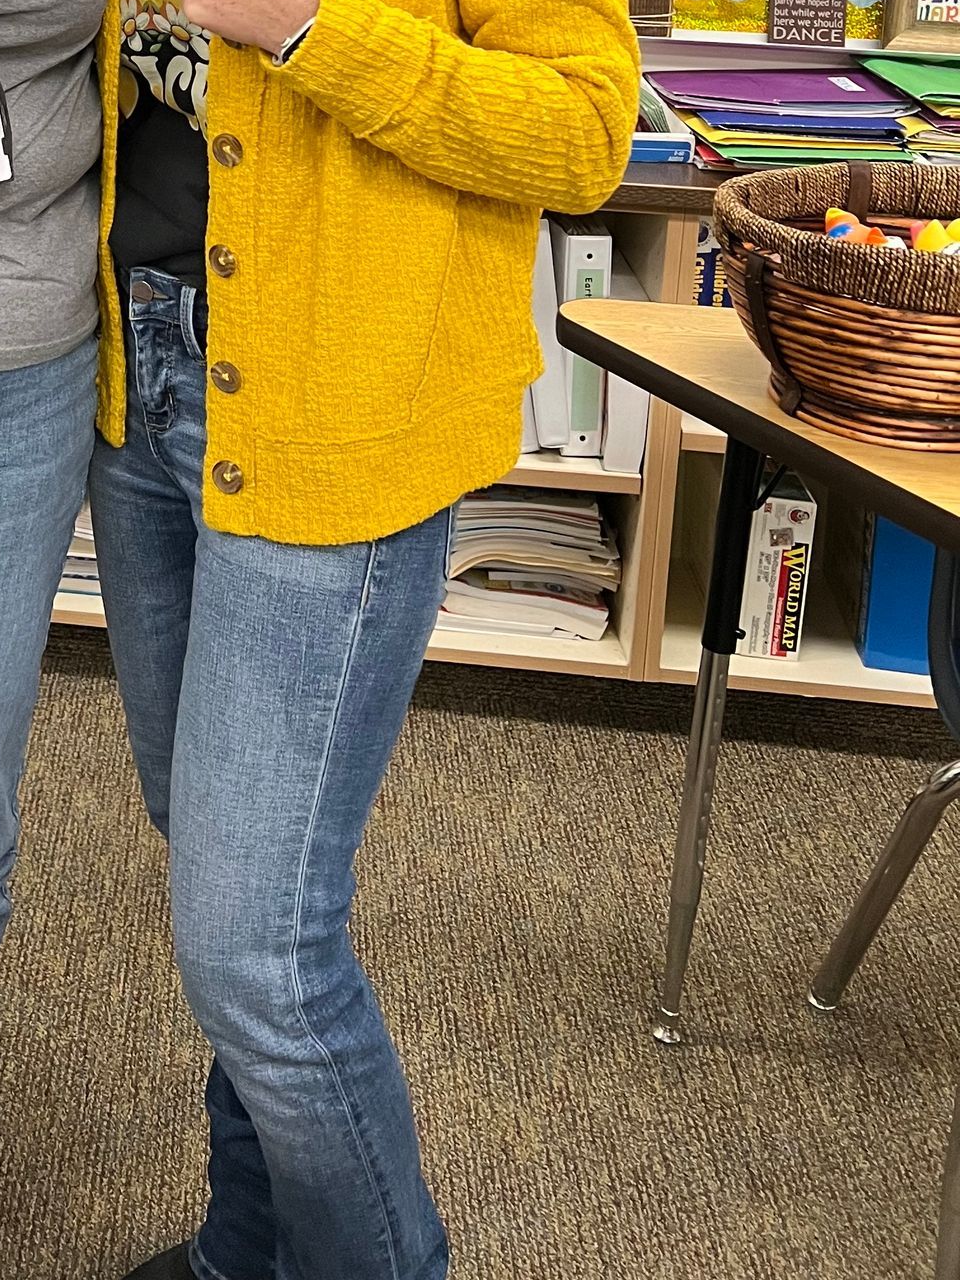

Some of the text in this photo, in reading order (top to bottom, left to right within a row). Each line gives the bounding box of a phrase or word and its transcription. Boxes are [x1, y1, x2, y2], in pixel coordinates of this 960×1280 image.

[774, 7, 844, 19] but while we're
[774, 16, 844, 29] here we should
[773, 26, 844, 43] DANCE
[584, 277, 593, 299] Eart
[782, 545, 806, 649] WORLD MAP
